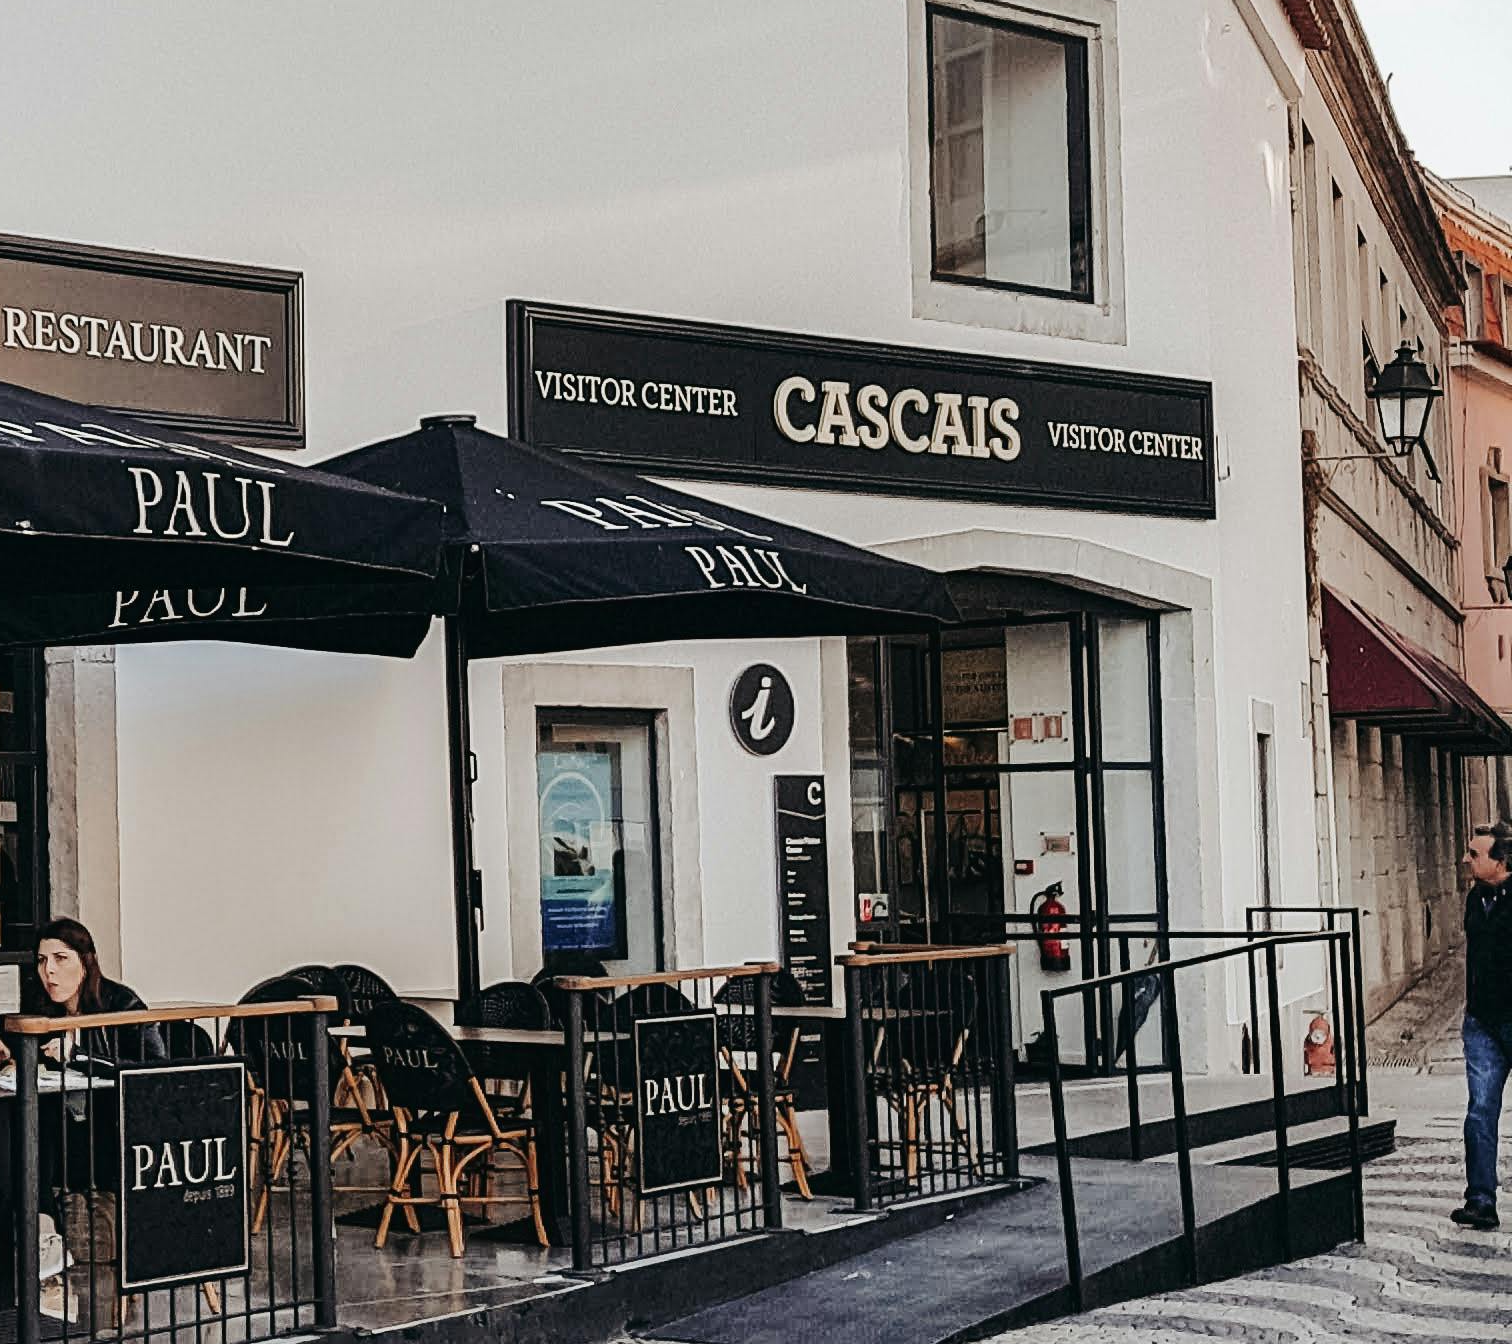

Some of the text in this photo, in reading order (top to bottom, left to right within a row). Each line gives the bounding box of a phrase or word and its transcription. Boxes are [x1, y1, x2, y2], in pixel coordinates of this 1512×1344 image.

[2, 306, 273, 376] RESTAURANT
[534, 369, 740, 418] VISITOR CENTER
[773, 375, 1022, 462] CASCAIS
[1047, 420, 1204, 461] VISITOR CENTER
[127, 466, 295, 548] PAUL
[684, 544, 808, 595] PAUL
[807, 780, 823, 806] C
[382, 1044, 439, 1070] PAUL
[644, 1072, 714, 1117] PAUL
[130, 1136, 238, 1193] PAUL
